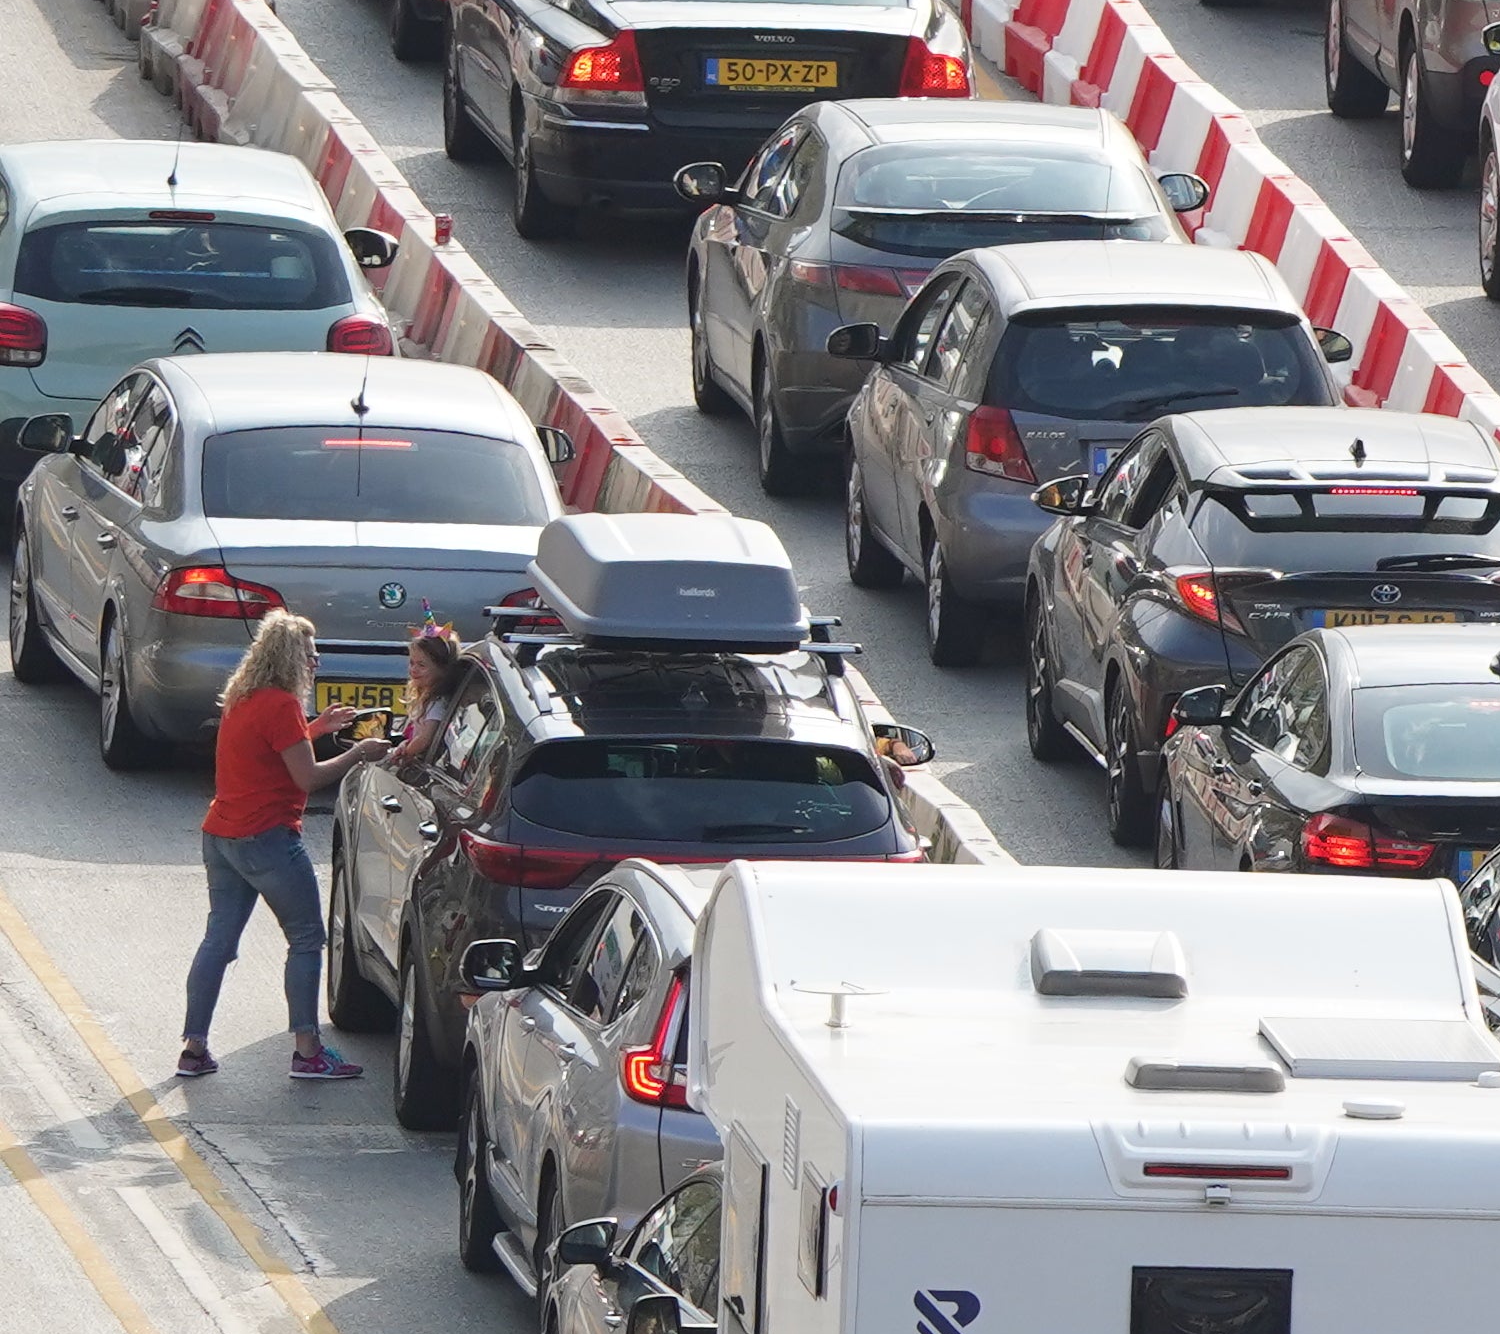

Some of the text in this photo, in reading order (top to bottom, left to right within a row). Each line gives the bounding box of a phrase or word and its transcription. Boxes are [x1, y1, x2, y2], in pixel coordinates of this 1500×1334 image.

[753, 34, 796, 43] VOLVO
[726, 61, 828, 82] 50-PX-ZP
[1248, 611, 1291, 620] C-HR
